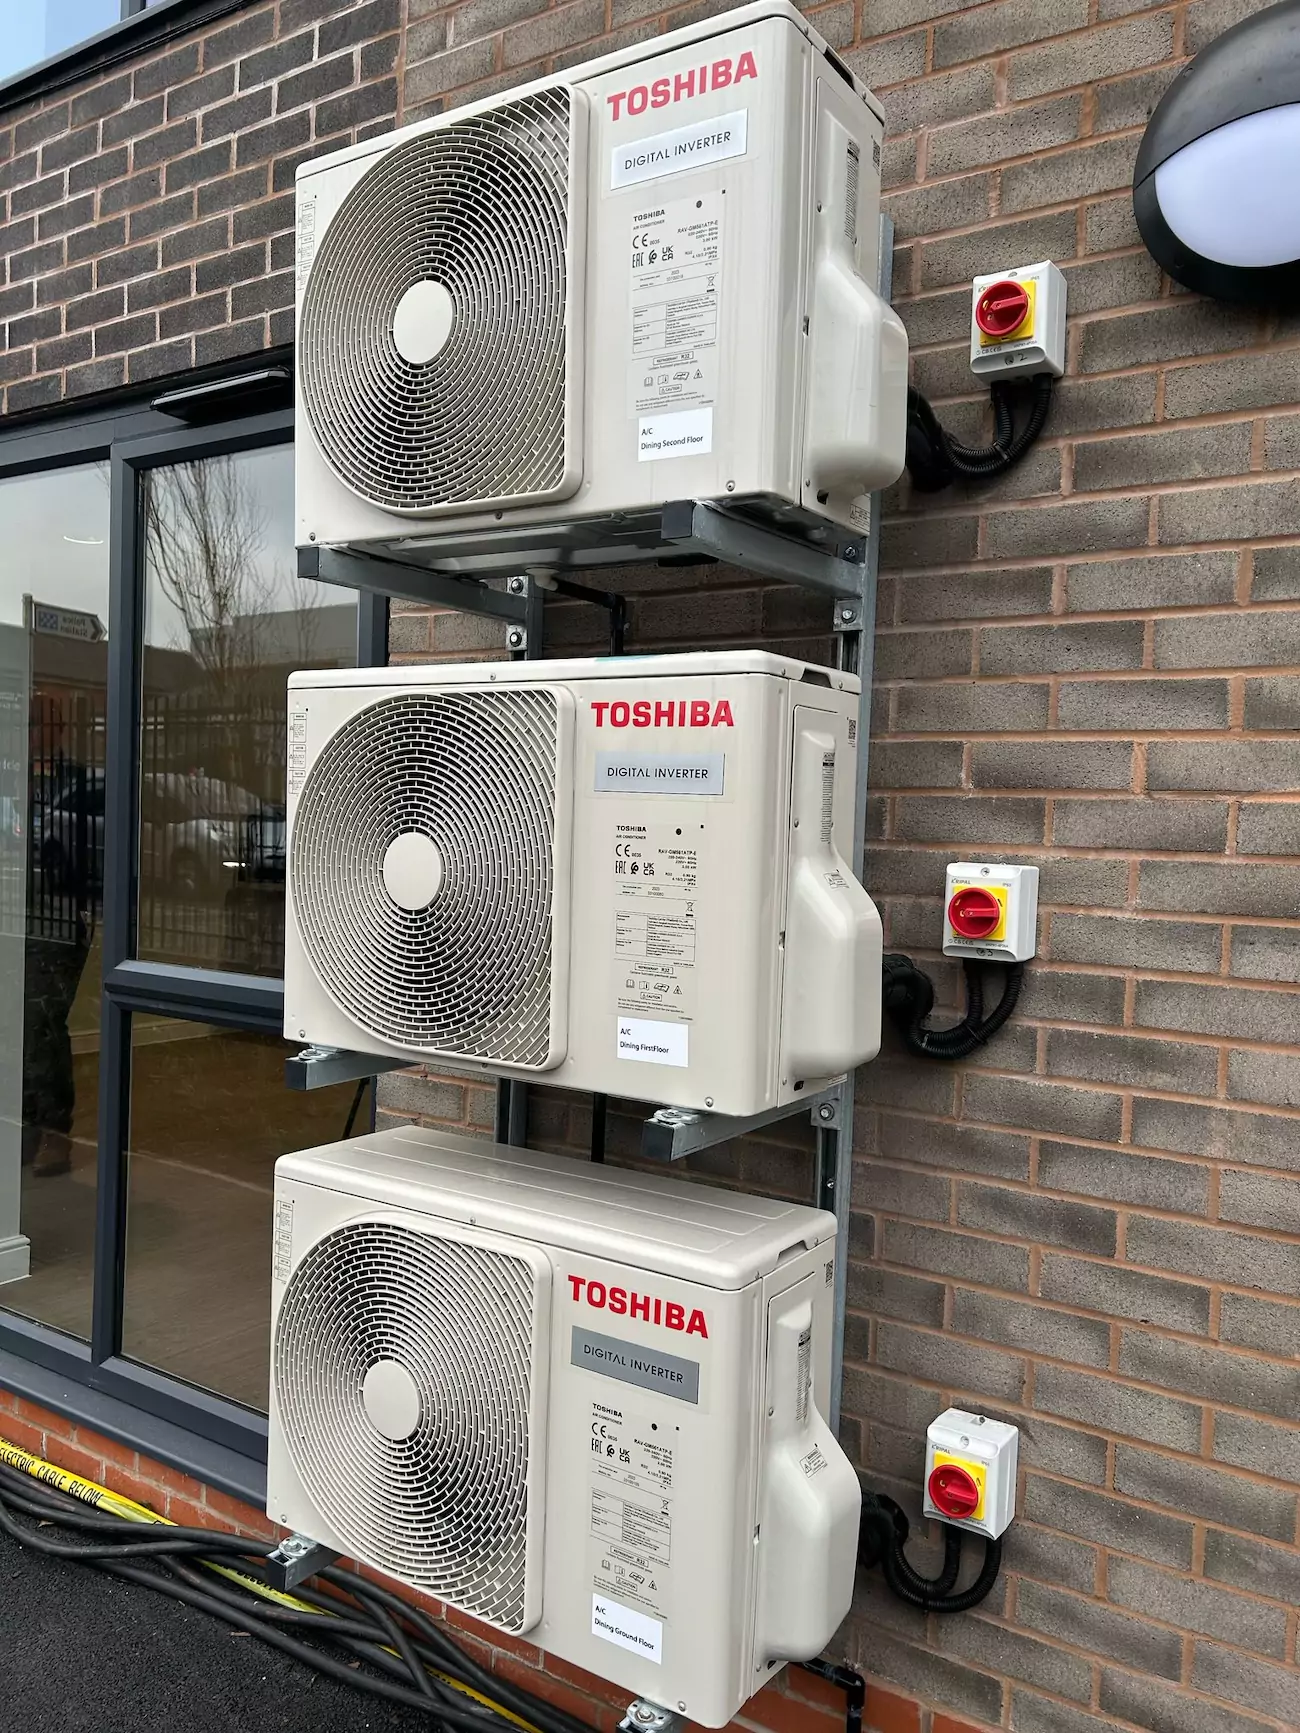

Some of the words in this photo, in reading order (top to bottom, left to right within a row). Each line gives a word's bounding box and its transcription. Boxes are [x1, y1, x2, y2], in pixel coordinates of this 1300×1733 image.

[607, 51, 758, 121] TOSHIBA
[624, 149, 669, 169] DIGITAL
[675, 131, 731, 156] INVERTER
[633, 209, 665, 222] TOSHIBA
[662, 253, 673, 261] CA
[1018, 353, 1027, 361] 2
[642, 428, 653, 436] A/C
[641, 442, 661, 450] Dining
[663, 438, 685, 447] Second
[591, 701, 734, 727] TOSHIBA
[608, 768, 650, 777] DIGITAL
[655, 768, 708, 778] INVERTER
[620, 1041, 639, 1051] Dining
[568, 1275, 708, 1339] TOSHIBA
[584, 1344, 626, 1366] DIGITAL
[631, 1359, 684, 1384] INVERTER
[593, 1403, 622, 1418] TOSHIBA
[620, 1448, 630, 1456] UK
[596, 1606, 606, 1615] A/C
[595, 1618, 614, 1633] Dining
[615, 1627, 637, 1643] Ground
[639, 1638, 654, 1650] Floor
